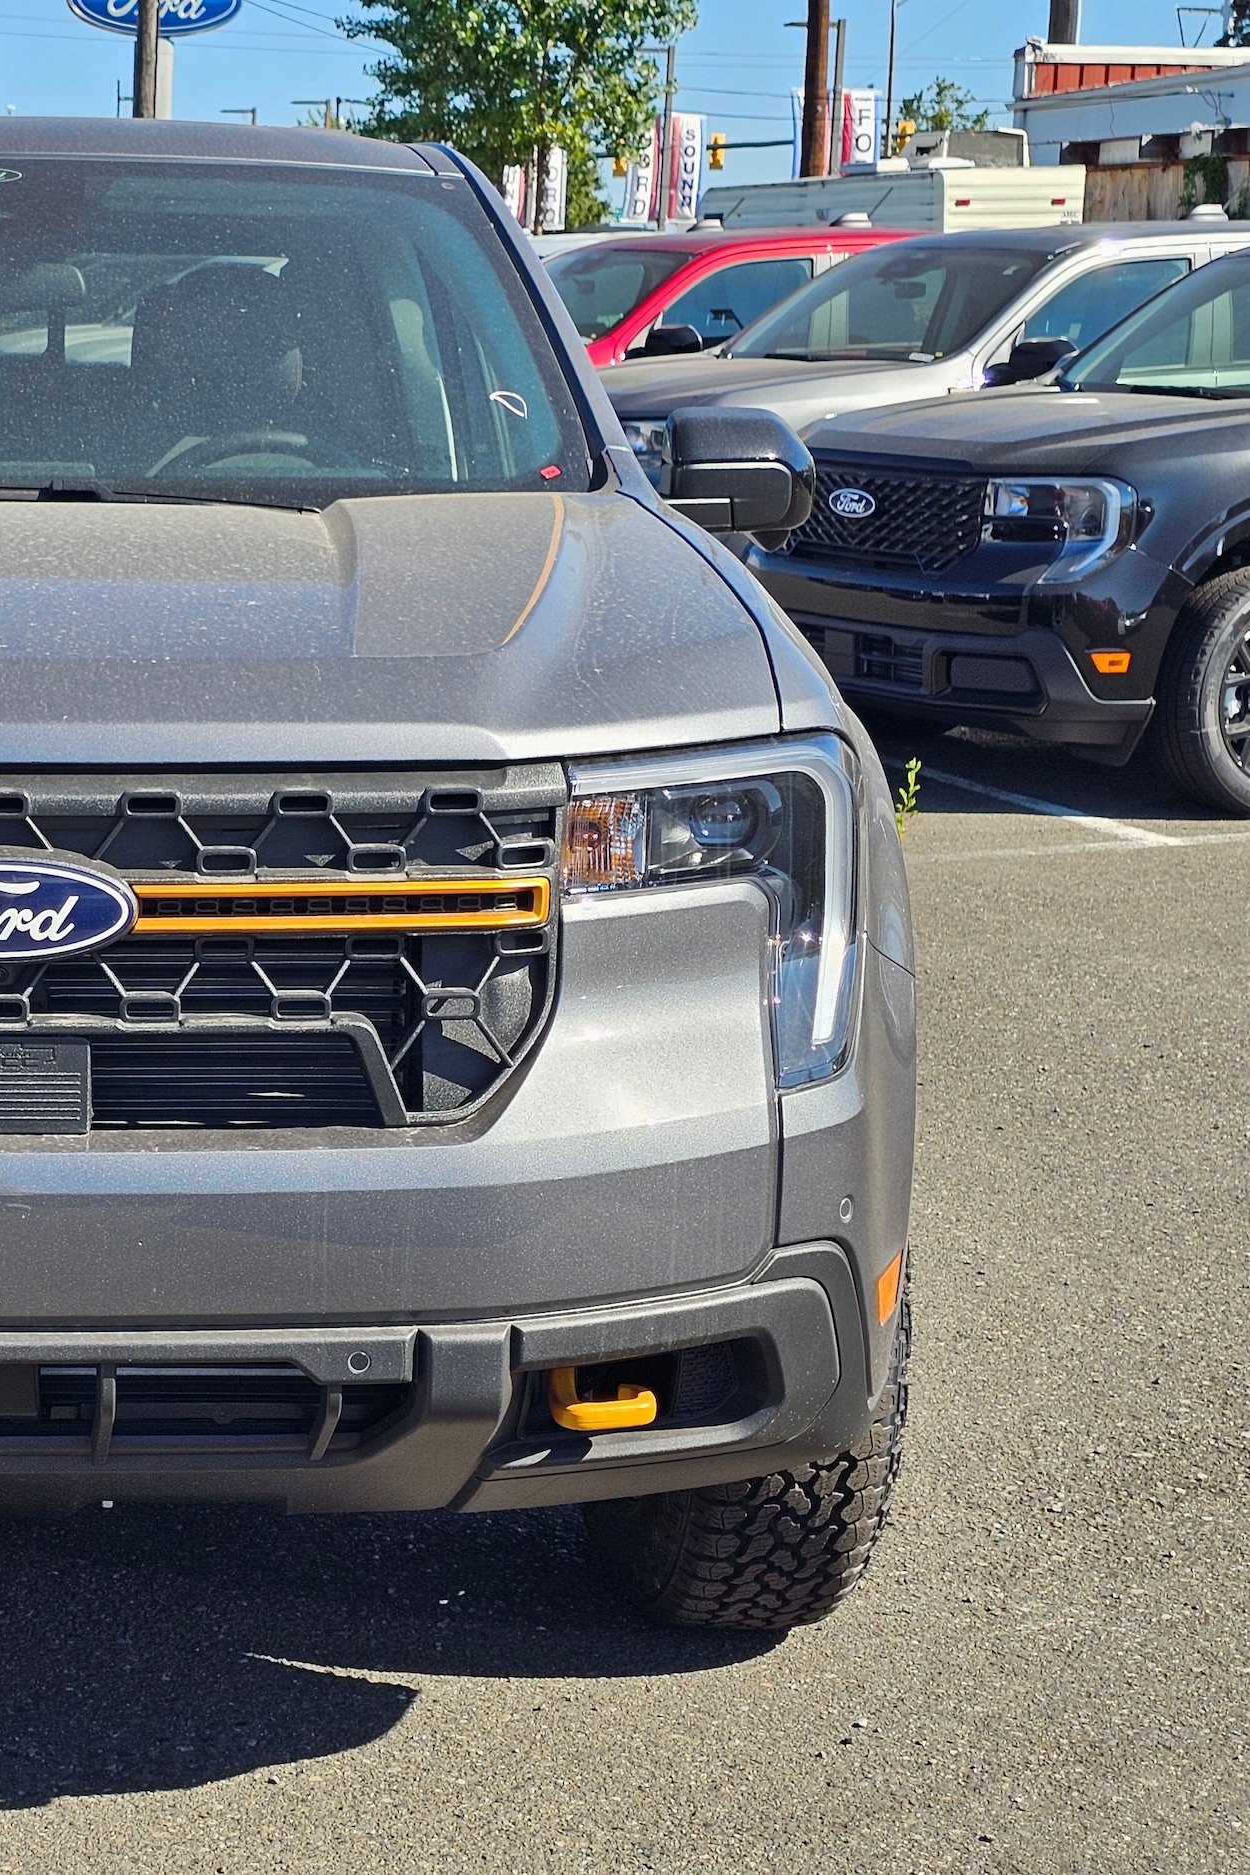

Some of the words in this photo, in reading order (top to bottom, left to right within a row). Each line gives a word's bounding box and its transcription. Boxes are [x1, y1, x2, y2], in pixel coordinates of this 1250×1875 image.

[107, 0, 207, 19] rd
[855, 109, 872, 164] FO
[542, 167, 559, 223] ORD
[633, 153, 651, 215] ORD
[837, 493, 867, 513] Ford
